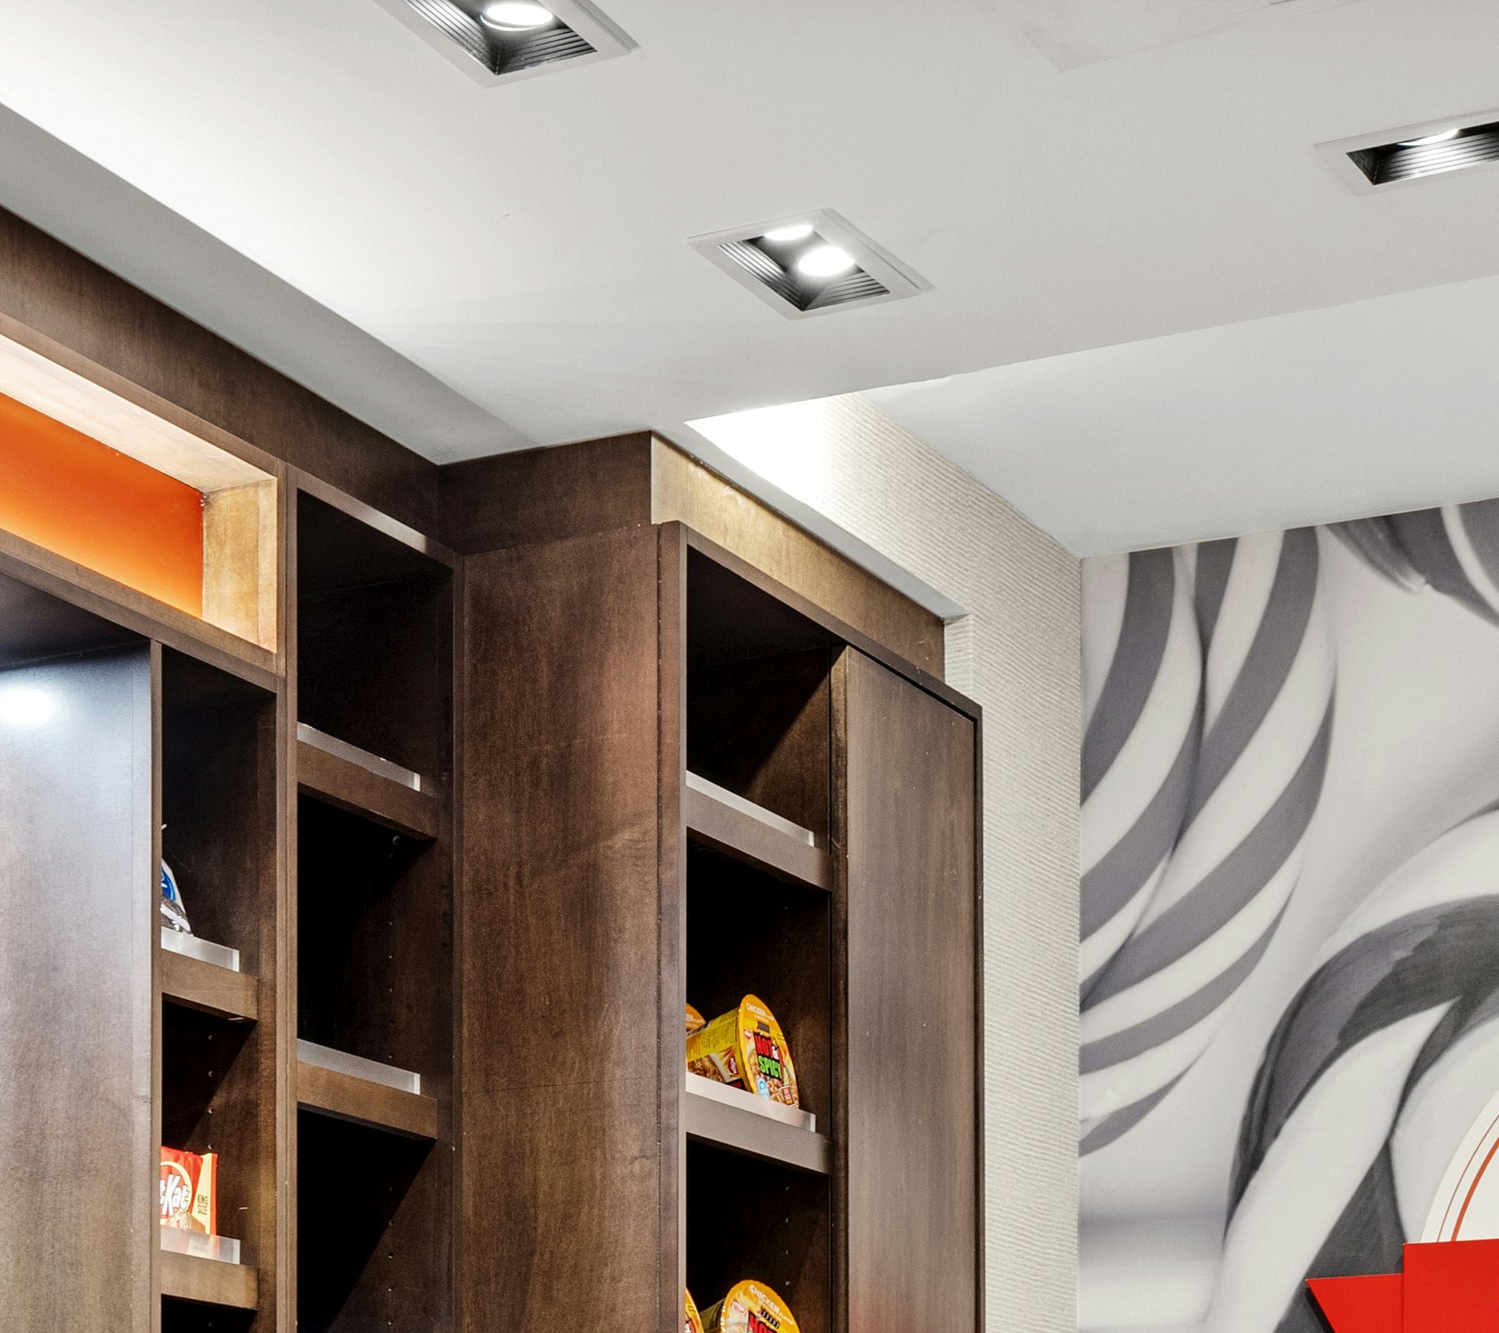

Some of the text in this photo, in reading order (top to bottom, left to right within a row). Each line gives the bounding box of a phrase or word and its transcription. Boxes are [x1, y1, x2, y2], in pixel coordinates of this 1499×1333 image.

[755, 1034, 773, 1057] HOT
[757, 1056, 781, 1081] SPICY
[750, 1284, 780, 1314] CHICKEN
